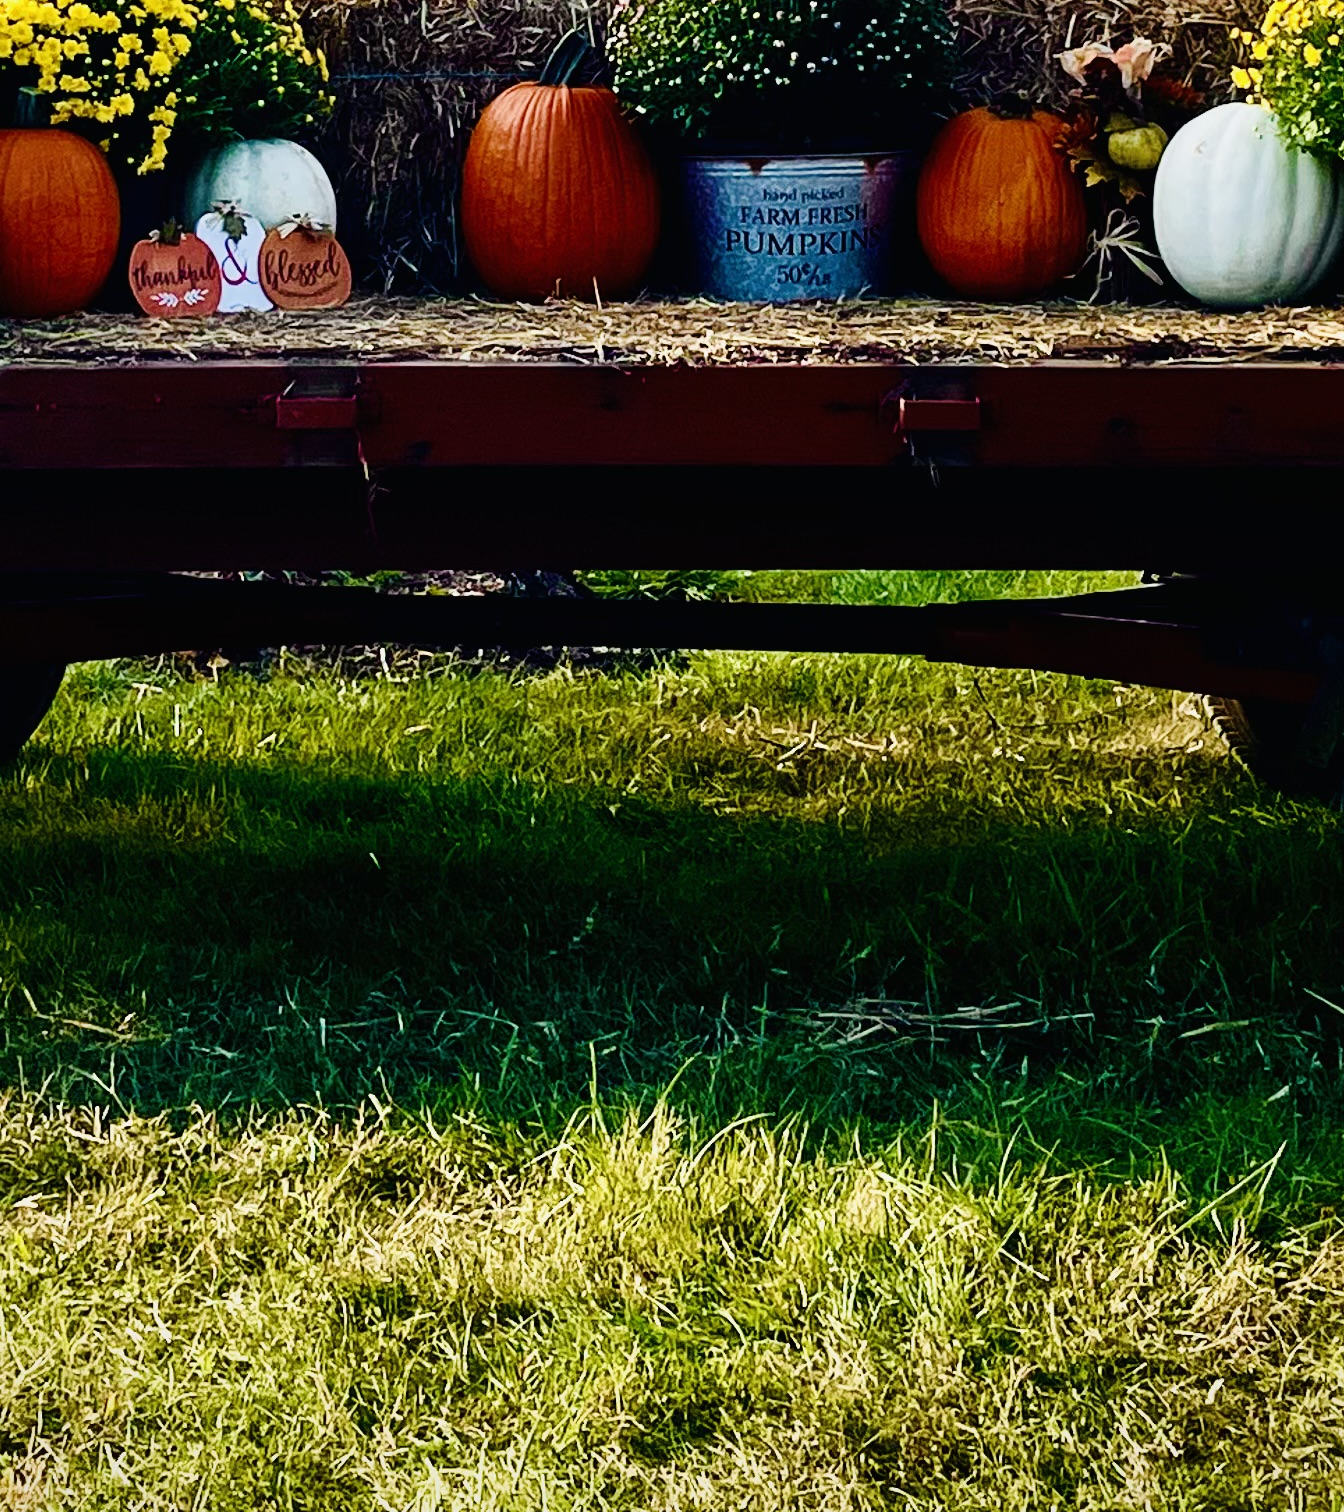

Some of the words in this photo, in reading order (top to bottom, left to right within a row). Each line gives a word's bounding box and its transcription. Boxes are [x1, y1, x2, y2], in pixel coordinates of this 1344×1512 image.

[739, 205, 801, 226] FARM
[807, 202, 869, 225] FRESH
[724, 224, 881, 257] PUMPKINS
[131, 249, 218, 292] thankful
[221, 236, 259, 286] &
[263, 241, 341, 292] blessed
